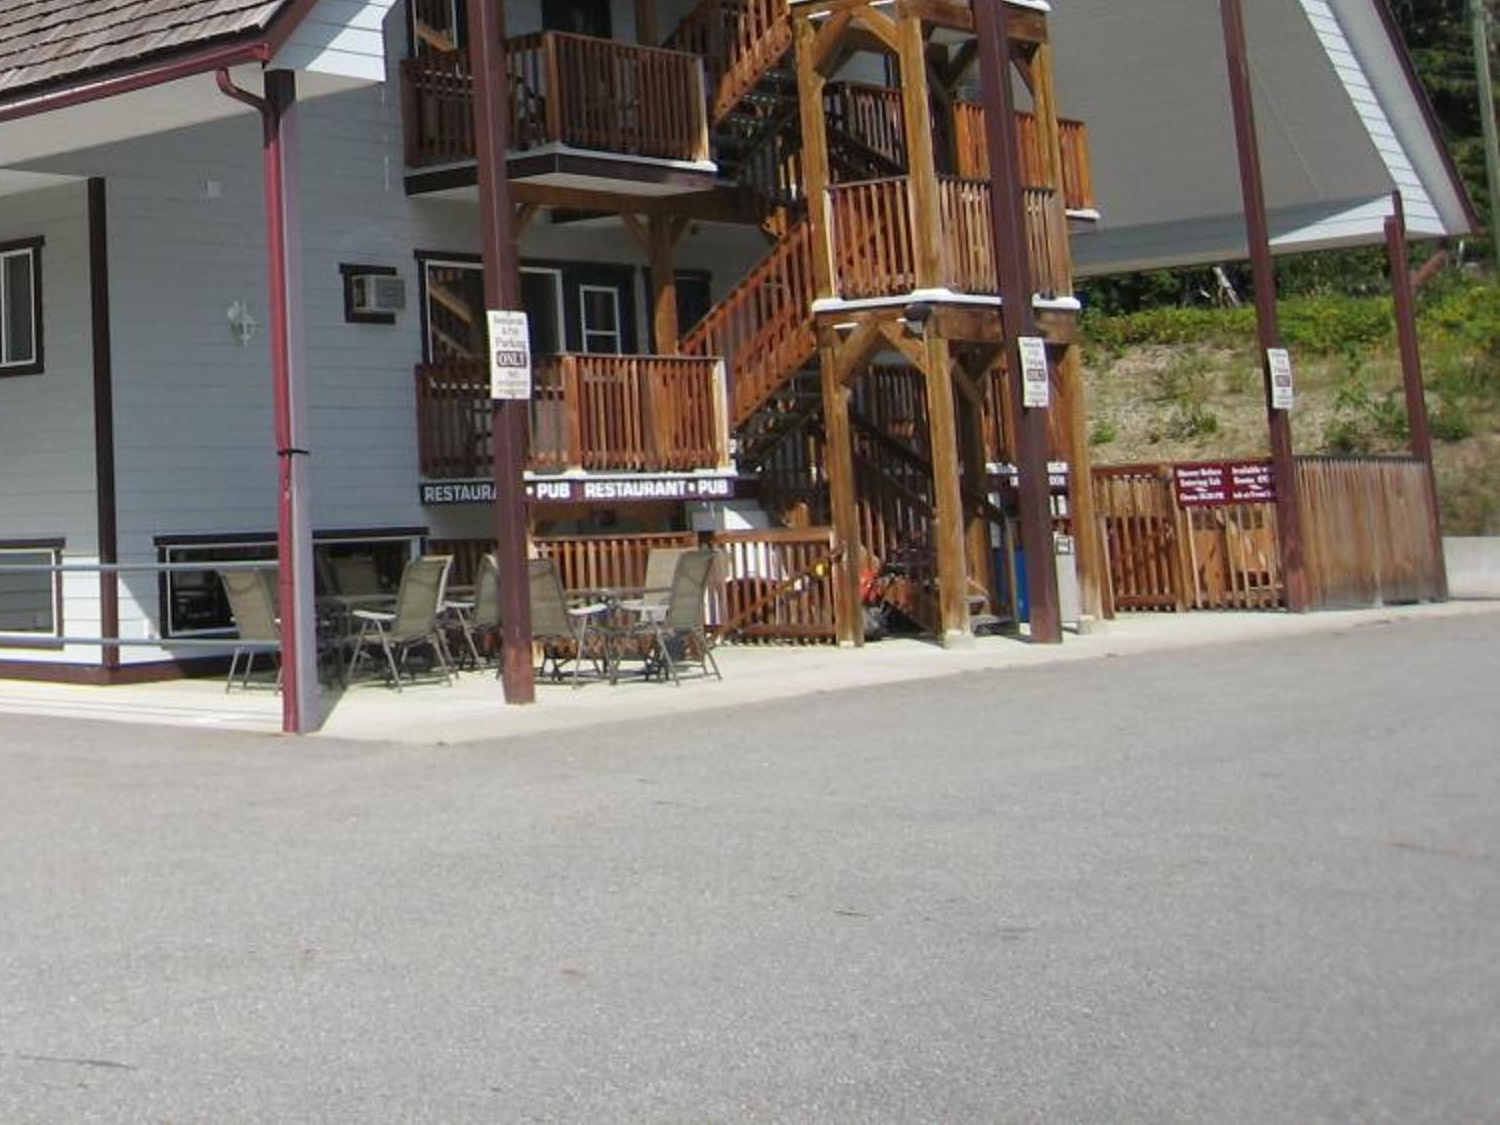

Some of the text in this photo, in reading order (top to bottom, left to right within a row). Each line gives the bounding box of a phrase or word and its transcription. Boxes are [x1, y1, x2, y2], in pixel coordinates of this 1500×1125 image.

[499, 352, 526, 366] ONLY
[536, 481, 572, 499] PUB
[583, 478, 729, 498] RESTAURANT PUB
